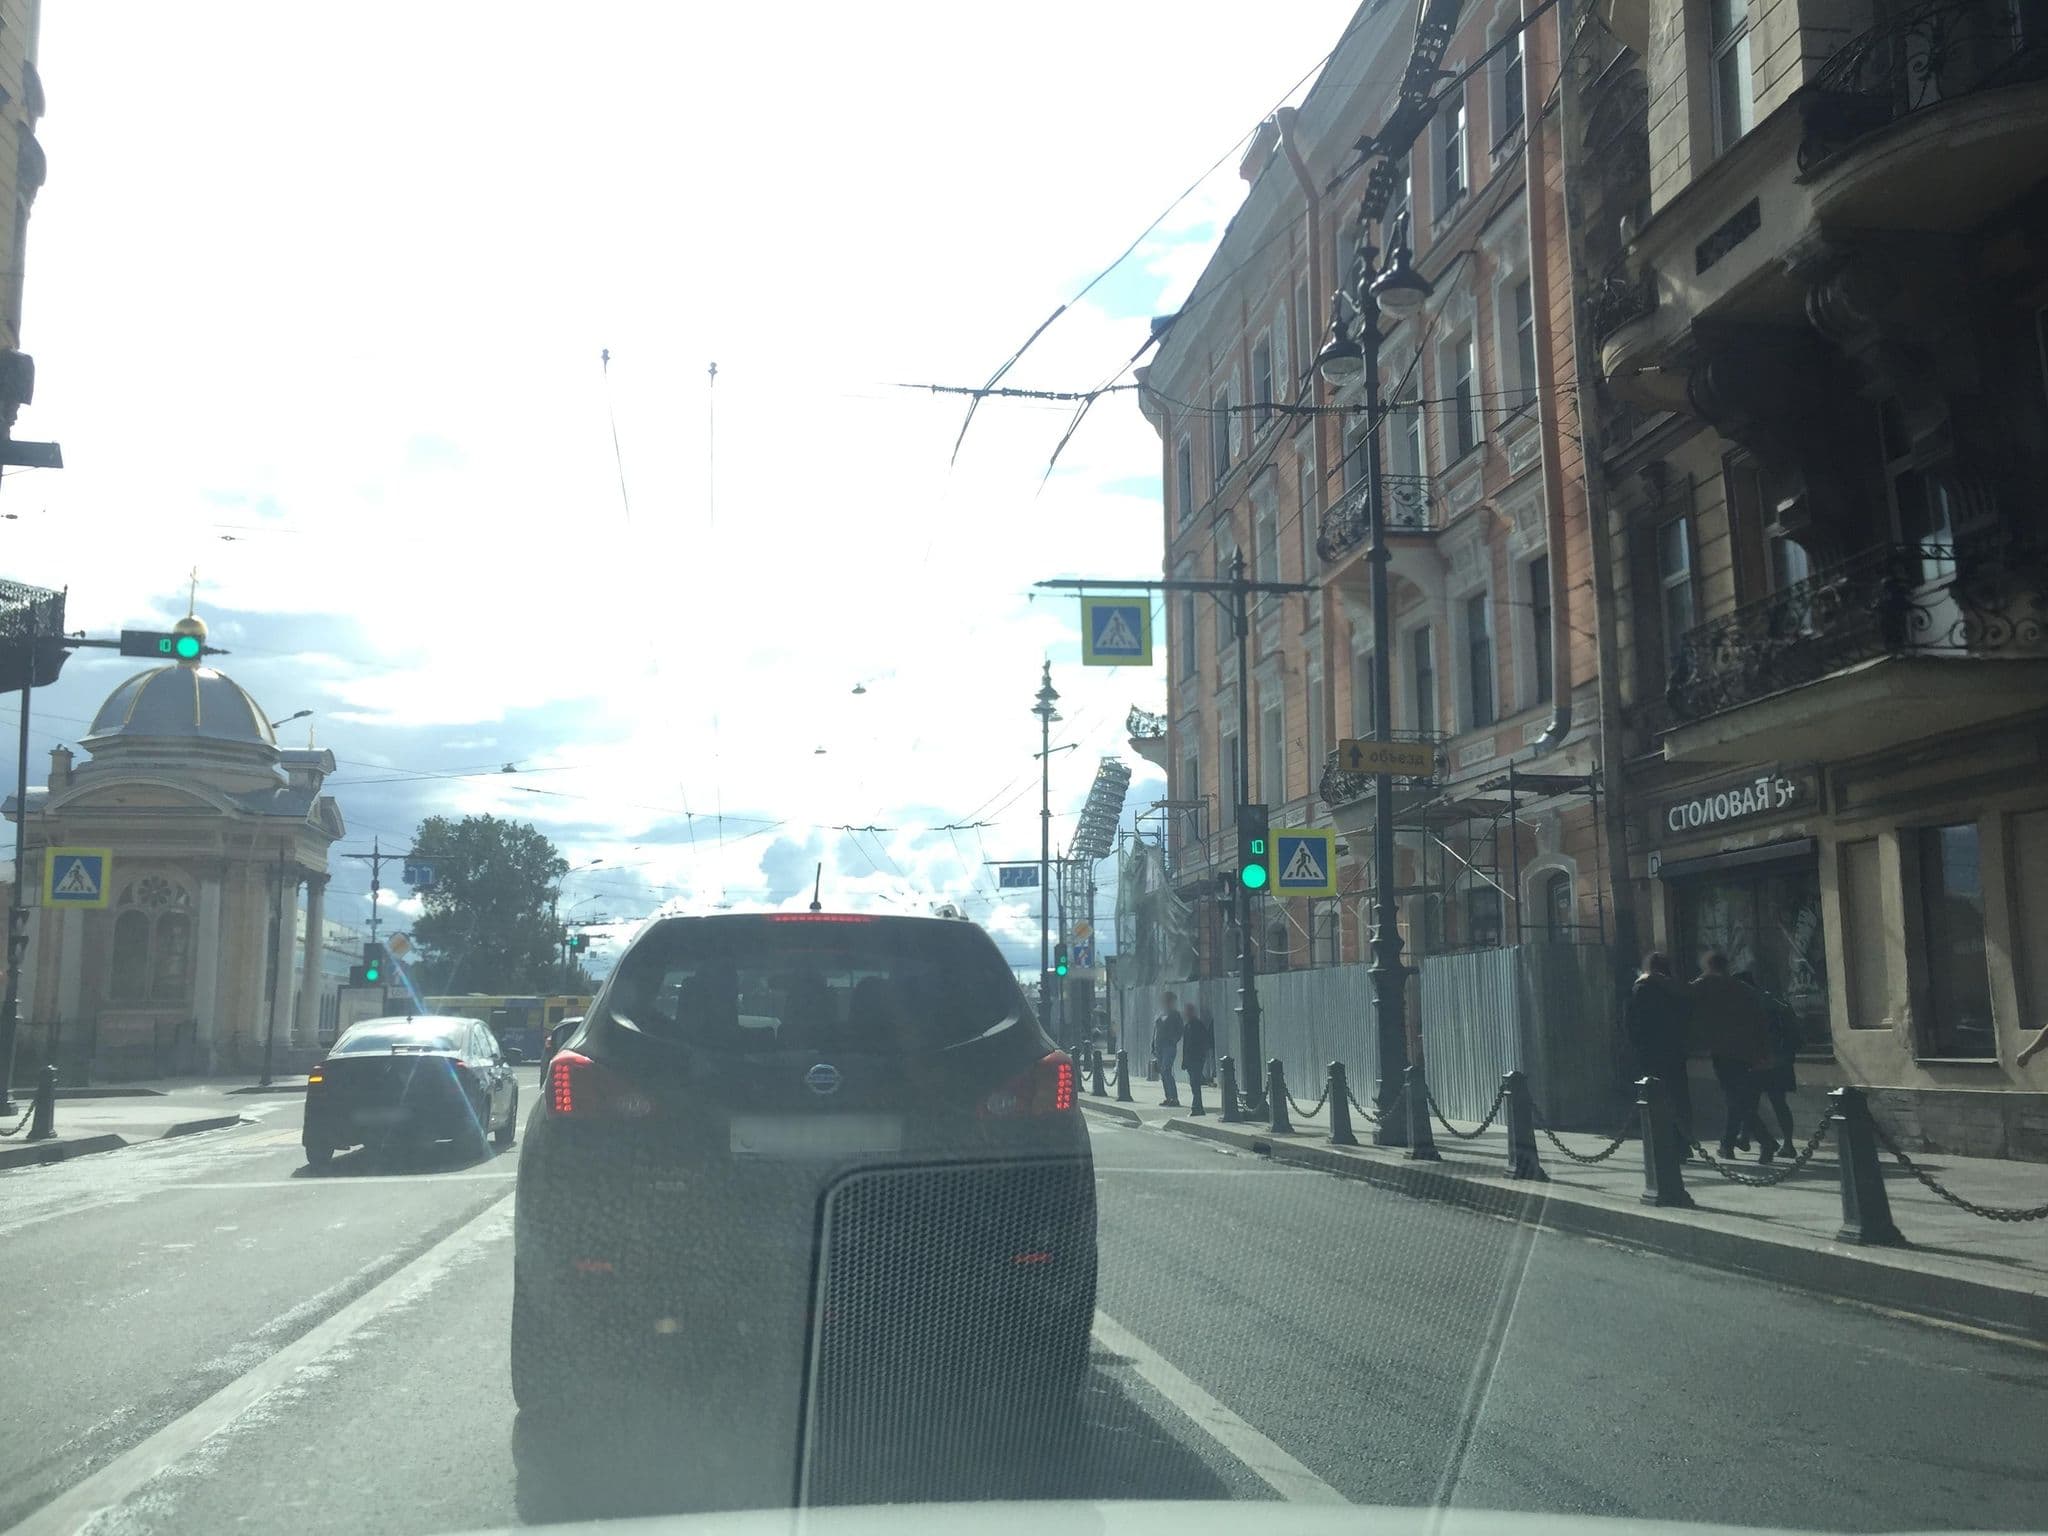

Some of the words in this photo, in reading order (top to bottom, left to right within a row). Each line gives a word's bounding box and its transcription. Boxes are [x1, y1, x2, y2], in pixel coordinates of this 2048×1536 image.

[1668, 779, 1770, 832] СТОЛОВАЯ
[1775, 778, 1796, 808] 5+
[1251, 839, 1264, 854] 10
